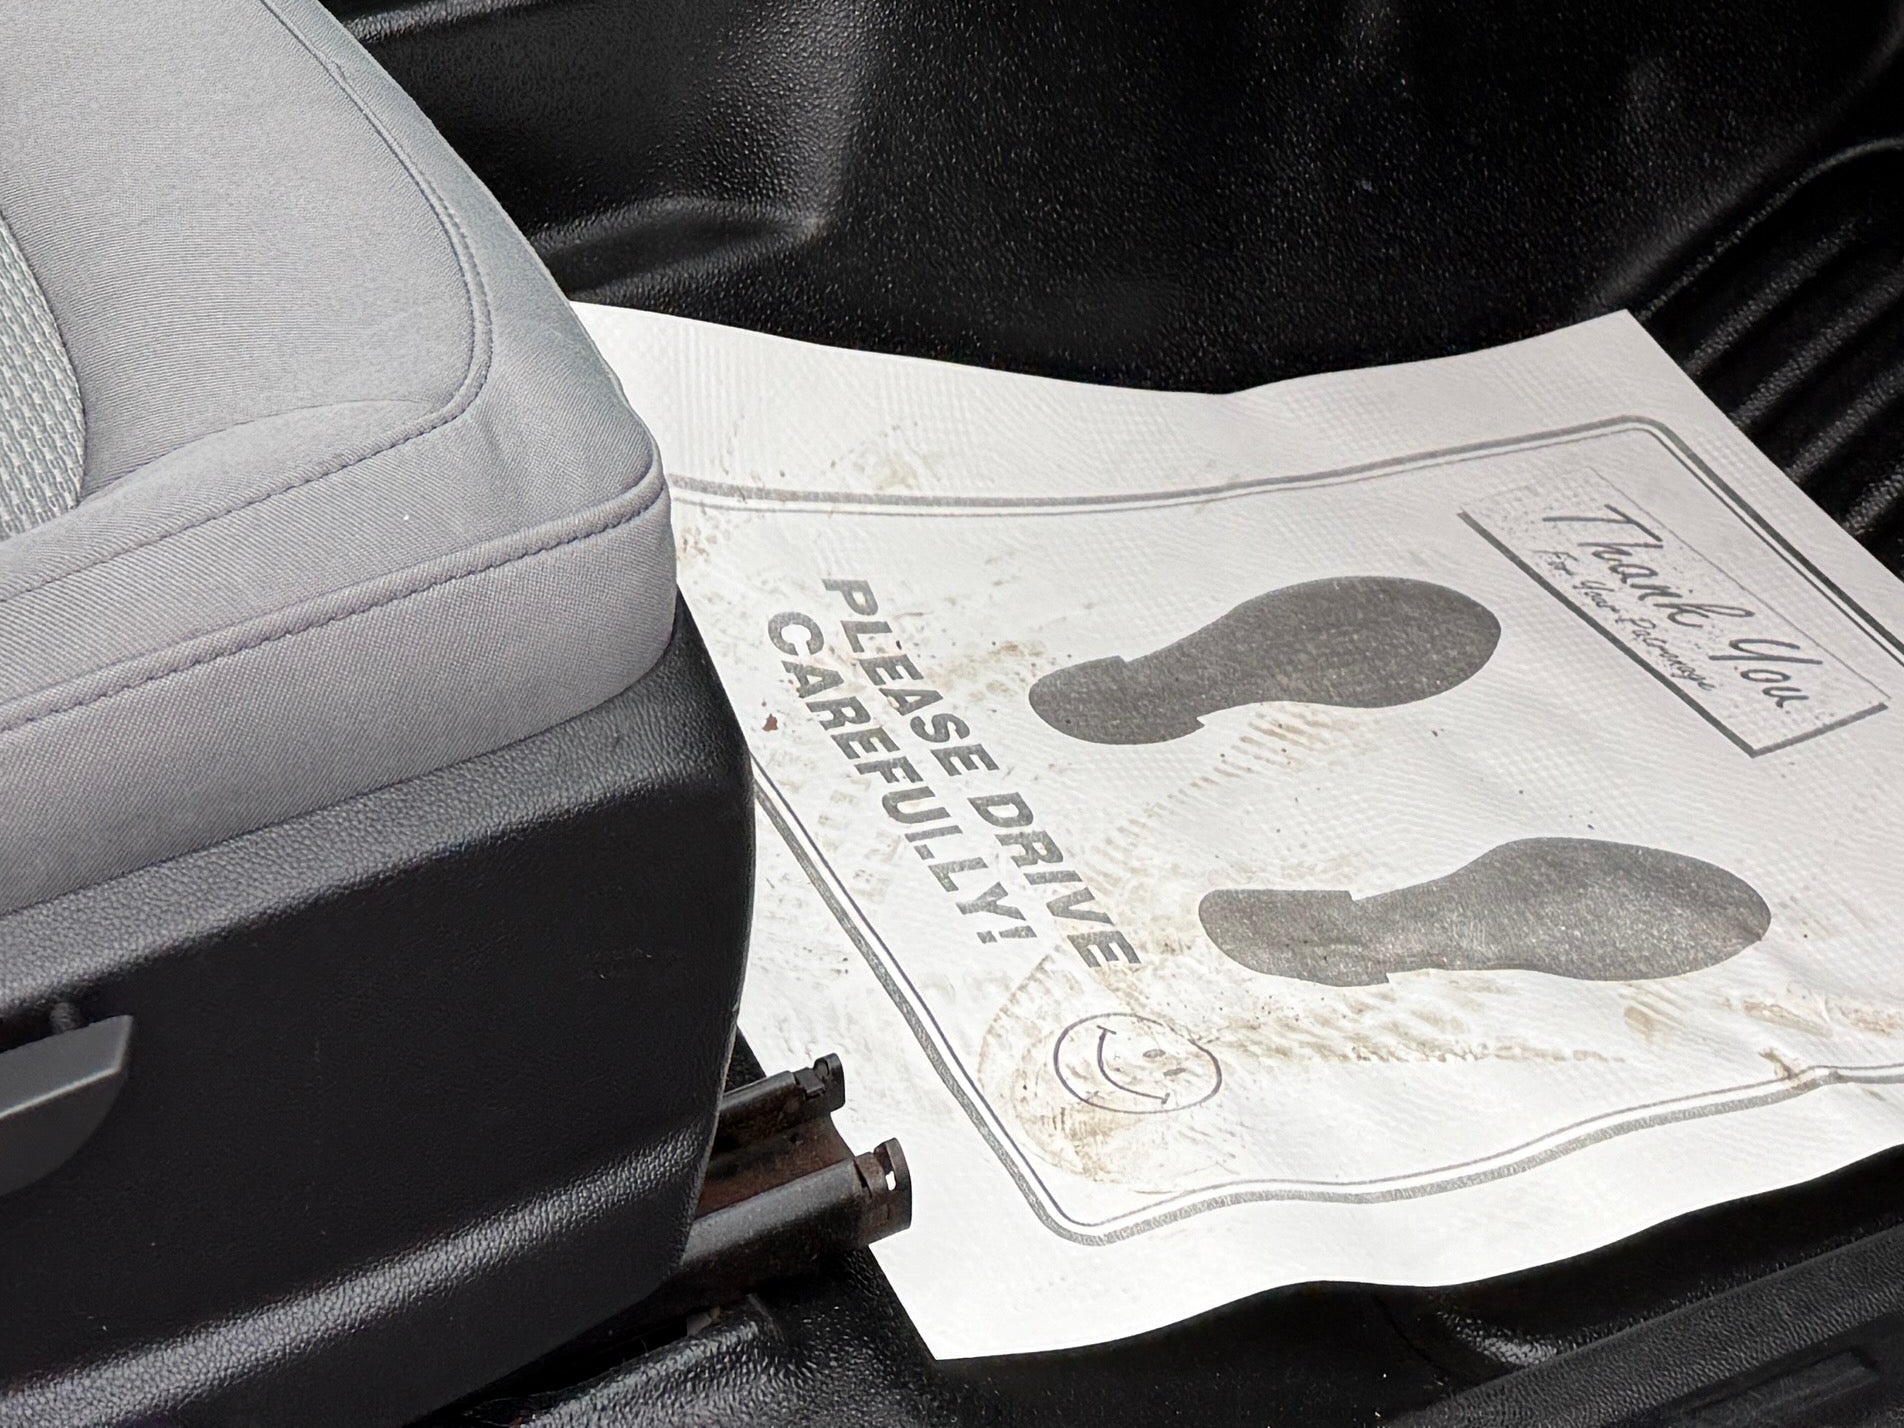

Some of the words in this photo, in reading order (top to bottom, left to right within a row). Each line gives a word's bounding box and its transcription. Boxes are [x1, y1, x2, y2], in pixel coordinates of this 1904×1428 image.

[821, 577, 1001, 777] PLEASE
[966, 790, 1143, 969] DRIVE
[1541, 503, 1756, 630] Thank
[1707, 637, 1825, 710] You
[767, 610, 1038, 945] CAREFULLY!
